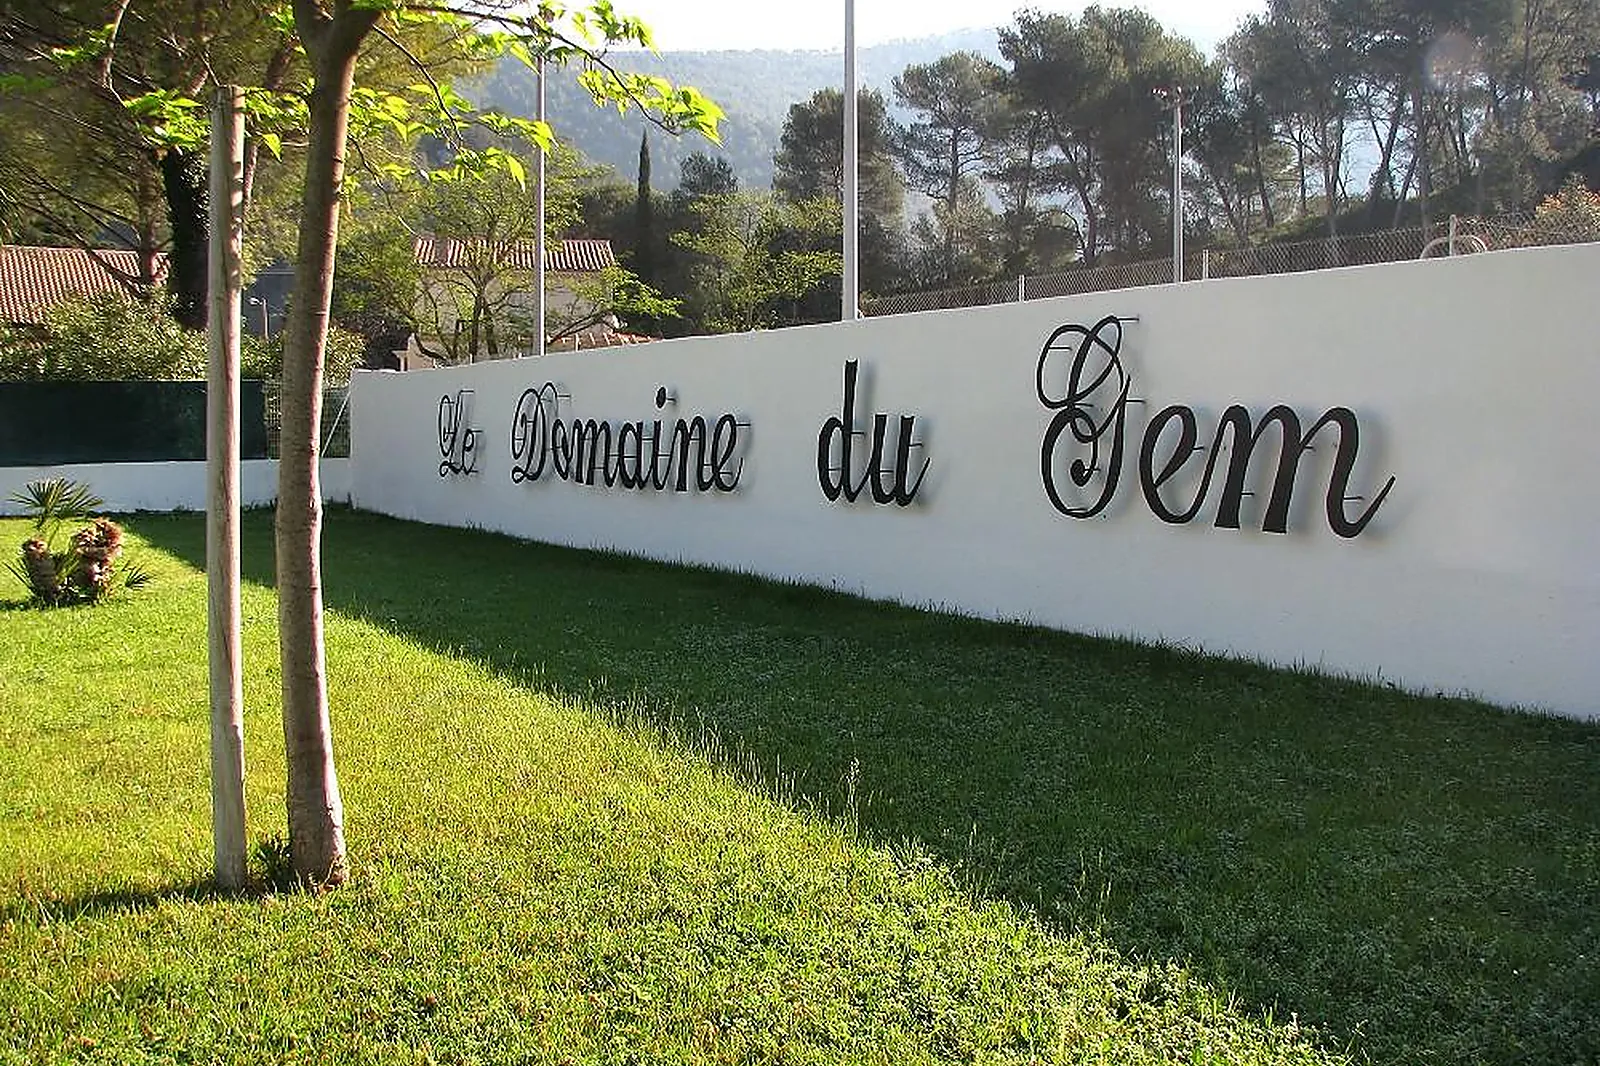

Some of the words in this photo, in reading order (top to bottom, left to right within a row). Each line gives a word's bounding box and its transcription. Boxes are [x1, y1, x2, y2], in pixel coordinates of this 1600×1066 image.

[438, 390, 477, 477] Le
[511, 382, 744, 492] Domaine
[817, 359, 931, 506] du
